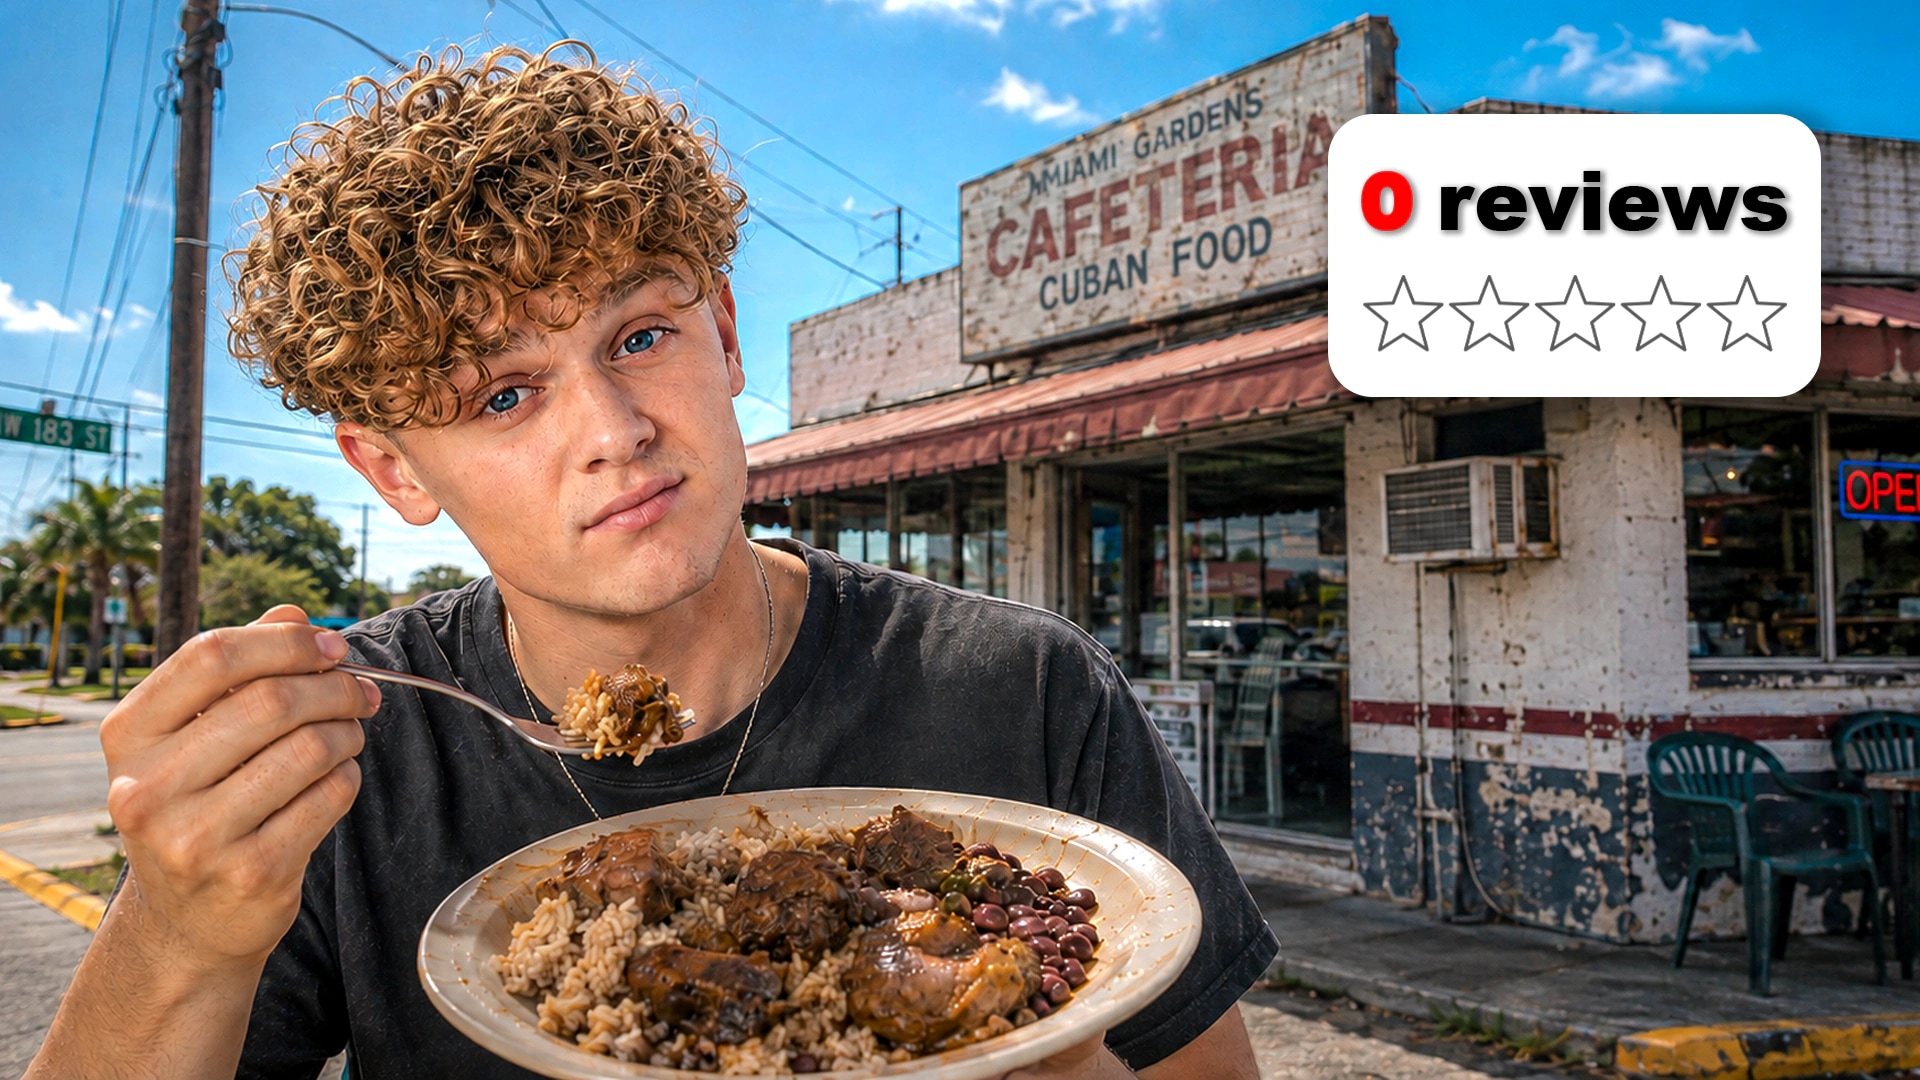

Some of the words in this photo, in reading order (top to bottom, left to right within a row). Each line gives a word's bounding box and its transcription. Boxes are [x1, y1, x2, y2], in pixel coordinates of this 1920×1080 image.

[1133, 87, 1264, 160] GARDENS
[987, 113, 1333, 279] CAFETERIA
[1039, 249, 1149, 311] CUBAN
[1172, 216, 1272, 278] FOOD
[0, 413, 22, 438] W
[34, 417, 74, 446] 183
[85, 425, 109, 449] ST
[1846, 469, 1920, 512] OPE
